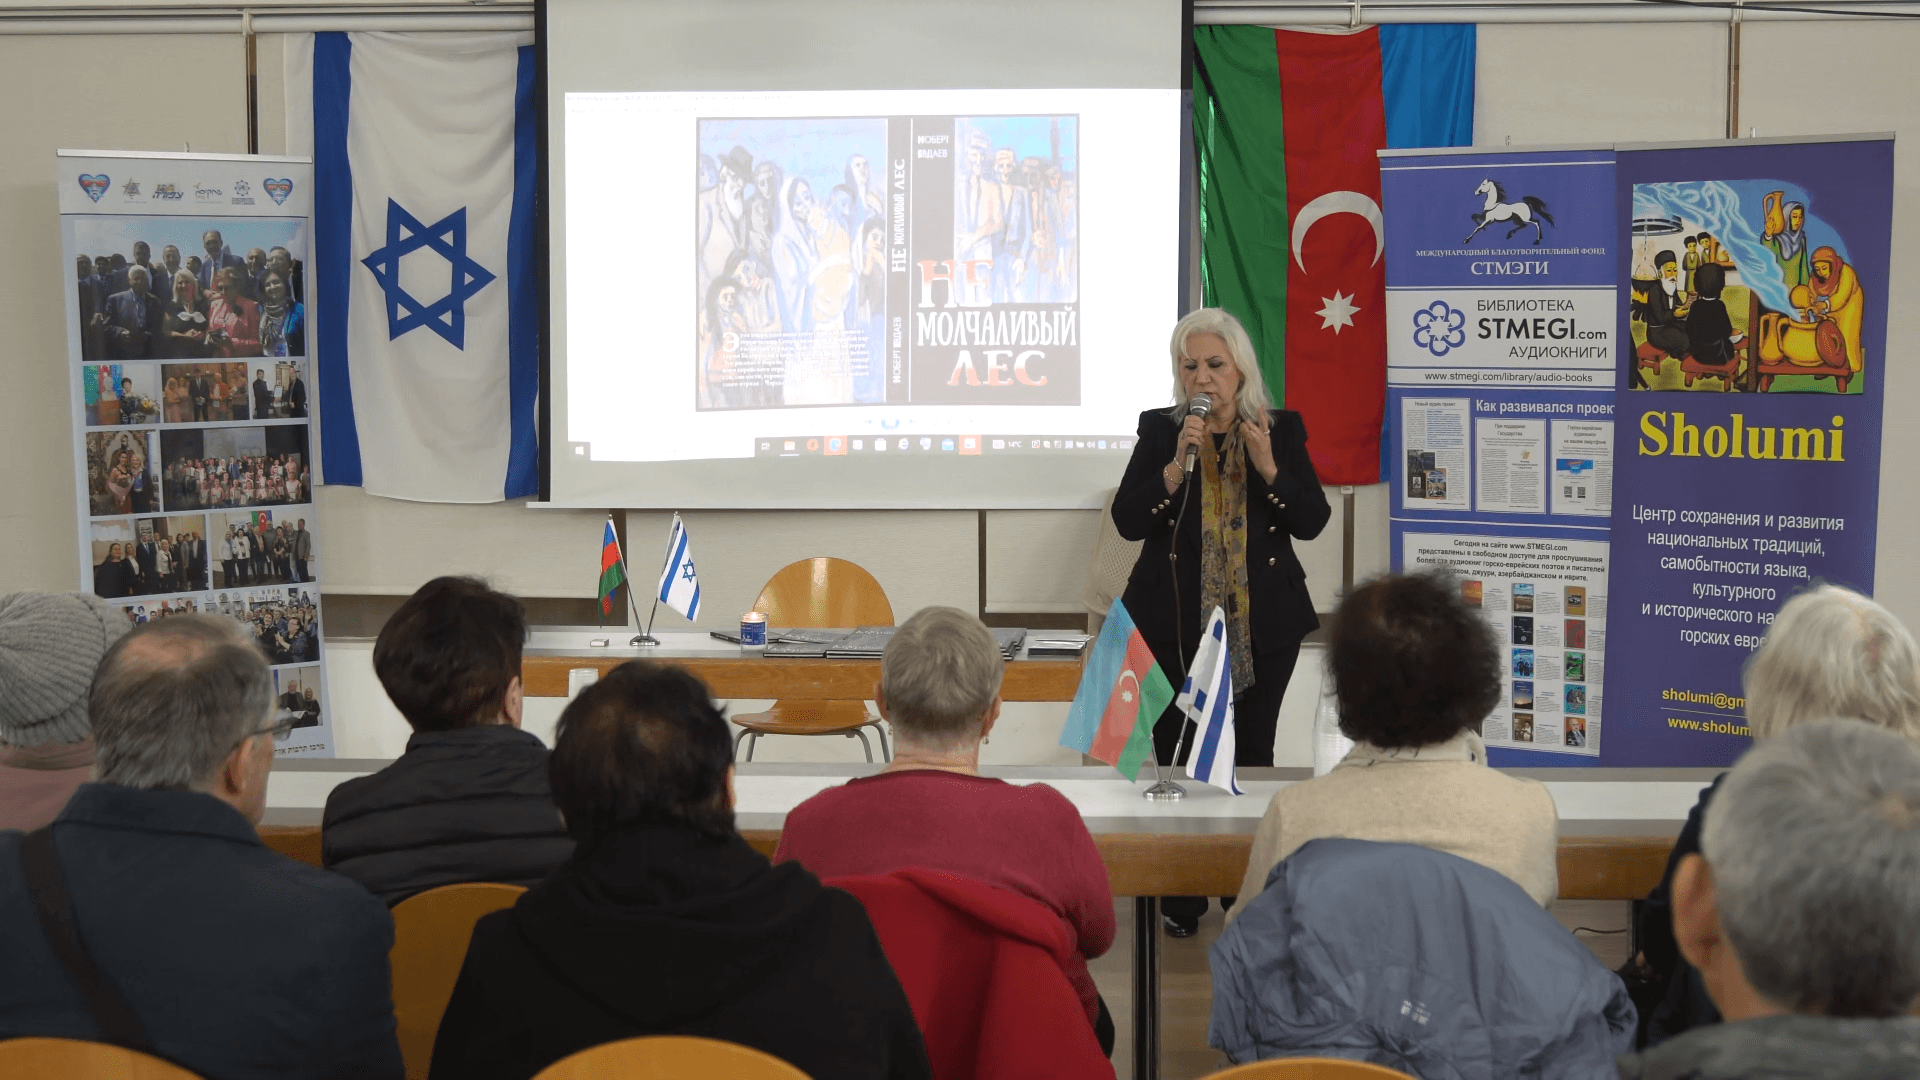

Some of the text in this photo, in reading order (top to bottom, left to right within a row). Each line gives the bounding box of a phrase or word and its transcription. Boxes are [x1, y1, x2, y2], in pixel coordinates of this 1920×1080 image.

[918, 149, 948, 160] ЕВДАЕВ
[891, 159, 907, 273] НЕ МОЛЧАЛИВЫЙ ЛЕС
[1416, 247, 1605, 257] МЕЖДУНАРОДНЫЙ БЛАГОТВОРИТЕЛЬНЫЙ ФОНД
[1471, 261, 1549, 275] СТМЭГИ
[917, 259, 995, 308] НЕ
[1477, 300, 1574, 311] БИБЛИОТЕКА
[893, 316, 902, 347] ЕВДАЕВ
[916, 306, 1077, 347] МОЛЧАЛИВЫЙ
[1477, 317, 1607, 340] STMEGI.com
[1509, 347, 1607, 360] АУДИОКНИГИ
[947, 349, 1048, 387] ЛЕС
[1425, 372, 1593, 383] www.stmegi.com/library/audio-books
[1476, 399, 1496, 412] Как
[1500, 402, 1573, 415] развивался
[1638, 411, 1845, 461] Sholumi
[1632, 504, 1844, 531] Центр сохранения и развития
[1454, 540, 1480, 548] Сегодня
[1510, 543, 1568, 551] www.STMEGI.com
[1648, 531, 1826, 557] национальных традиций,
[1419, 548, 1465, 556] представлены
[1473, 550, 1507, 558] свободном
[1552, 554, 1602, 562] прослушивания
[1483, 560, 1540, 569] горско-еврейских
[1498, 571, 1557, 579] азербайджанском
[1660, 555, 1811, 580] самобытности языка,
[1693, 581, 1776, 601] культурного
[1642, 602, 1650, 614] и
[1655, 604, 1753, 624] исторического
[1680, 629, 1730, 647] горских
